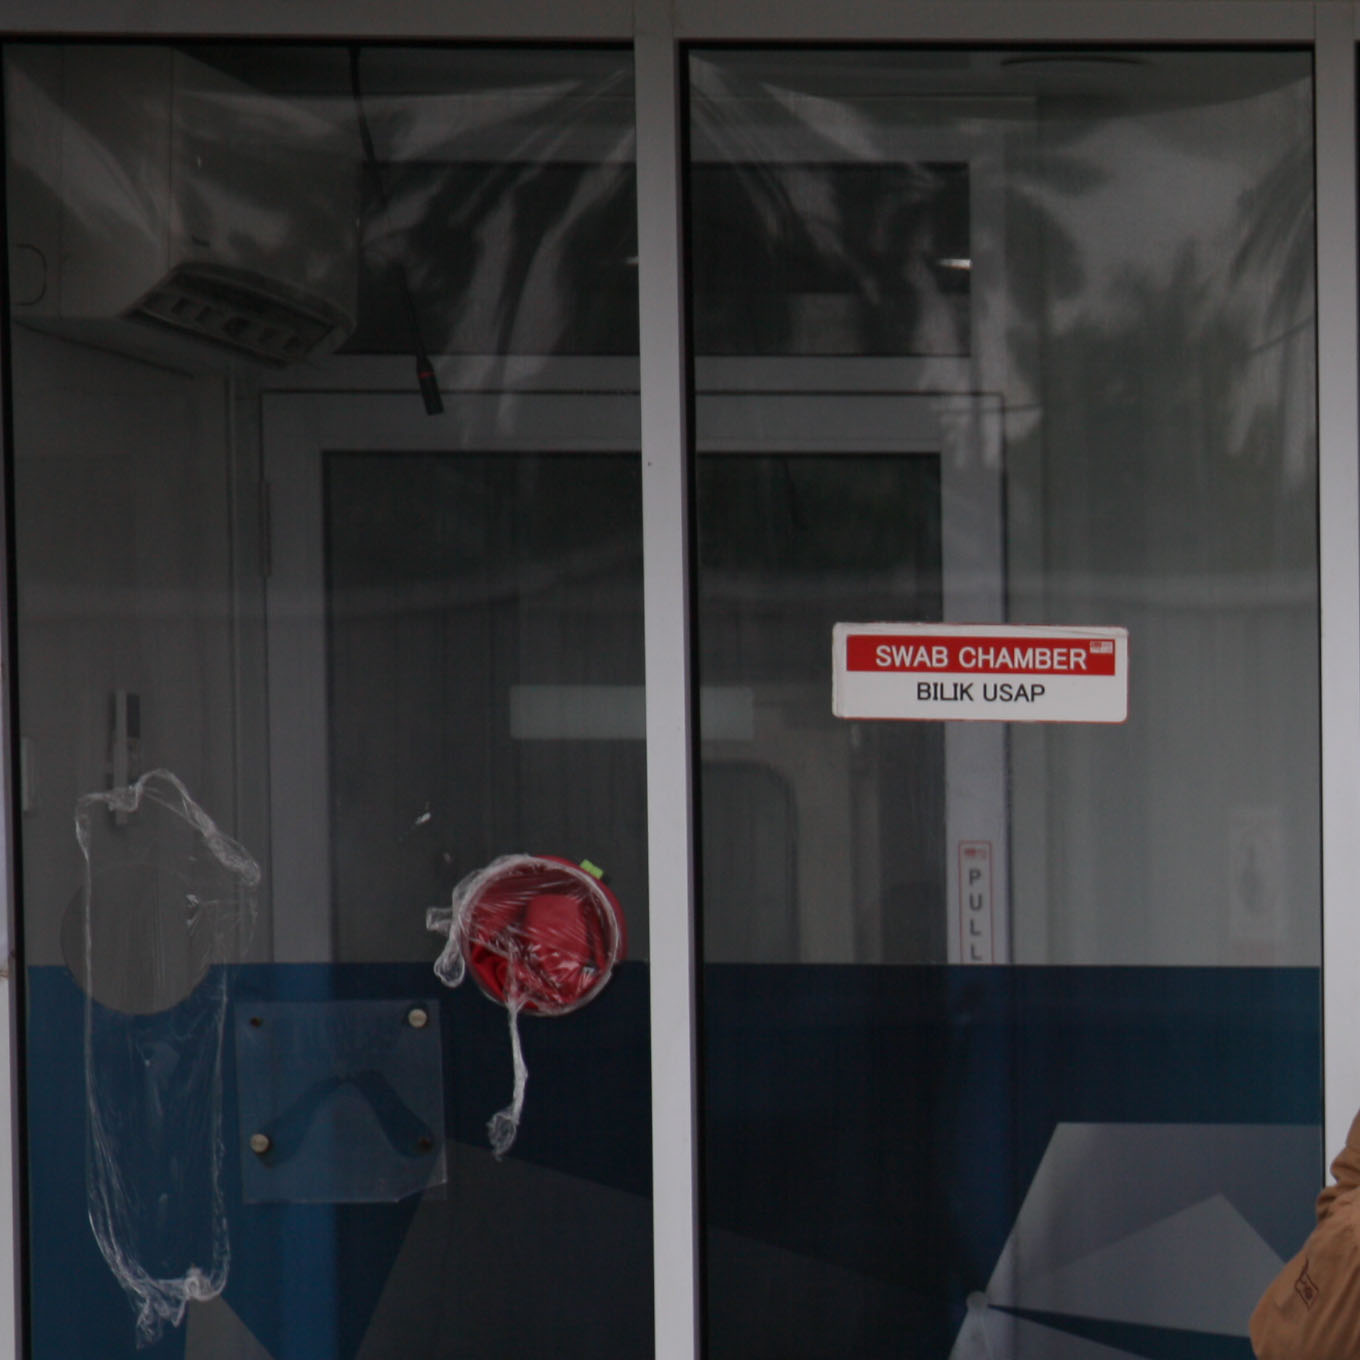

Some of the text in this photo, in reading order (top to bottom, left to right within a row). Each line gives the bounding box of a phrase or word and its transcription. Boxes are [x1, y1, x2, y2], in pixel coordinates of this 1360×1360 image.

[875, 645, 948, 668] SWAB
[959, 647, 1087, 670] CHAMBER
[916, 682, 1046, 703] BILIK USAP
[968, 867, 983, 961] PULL
